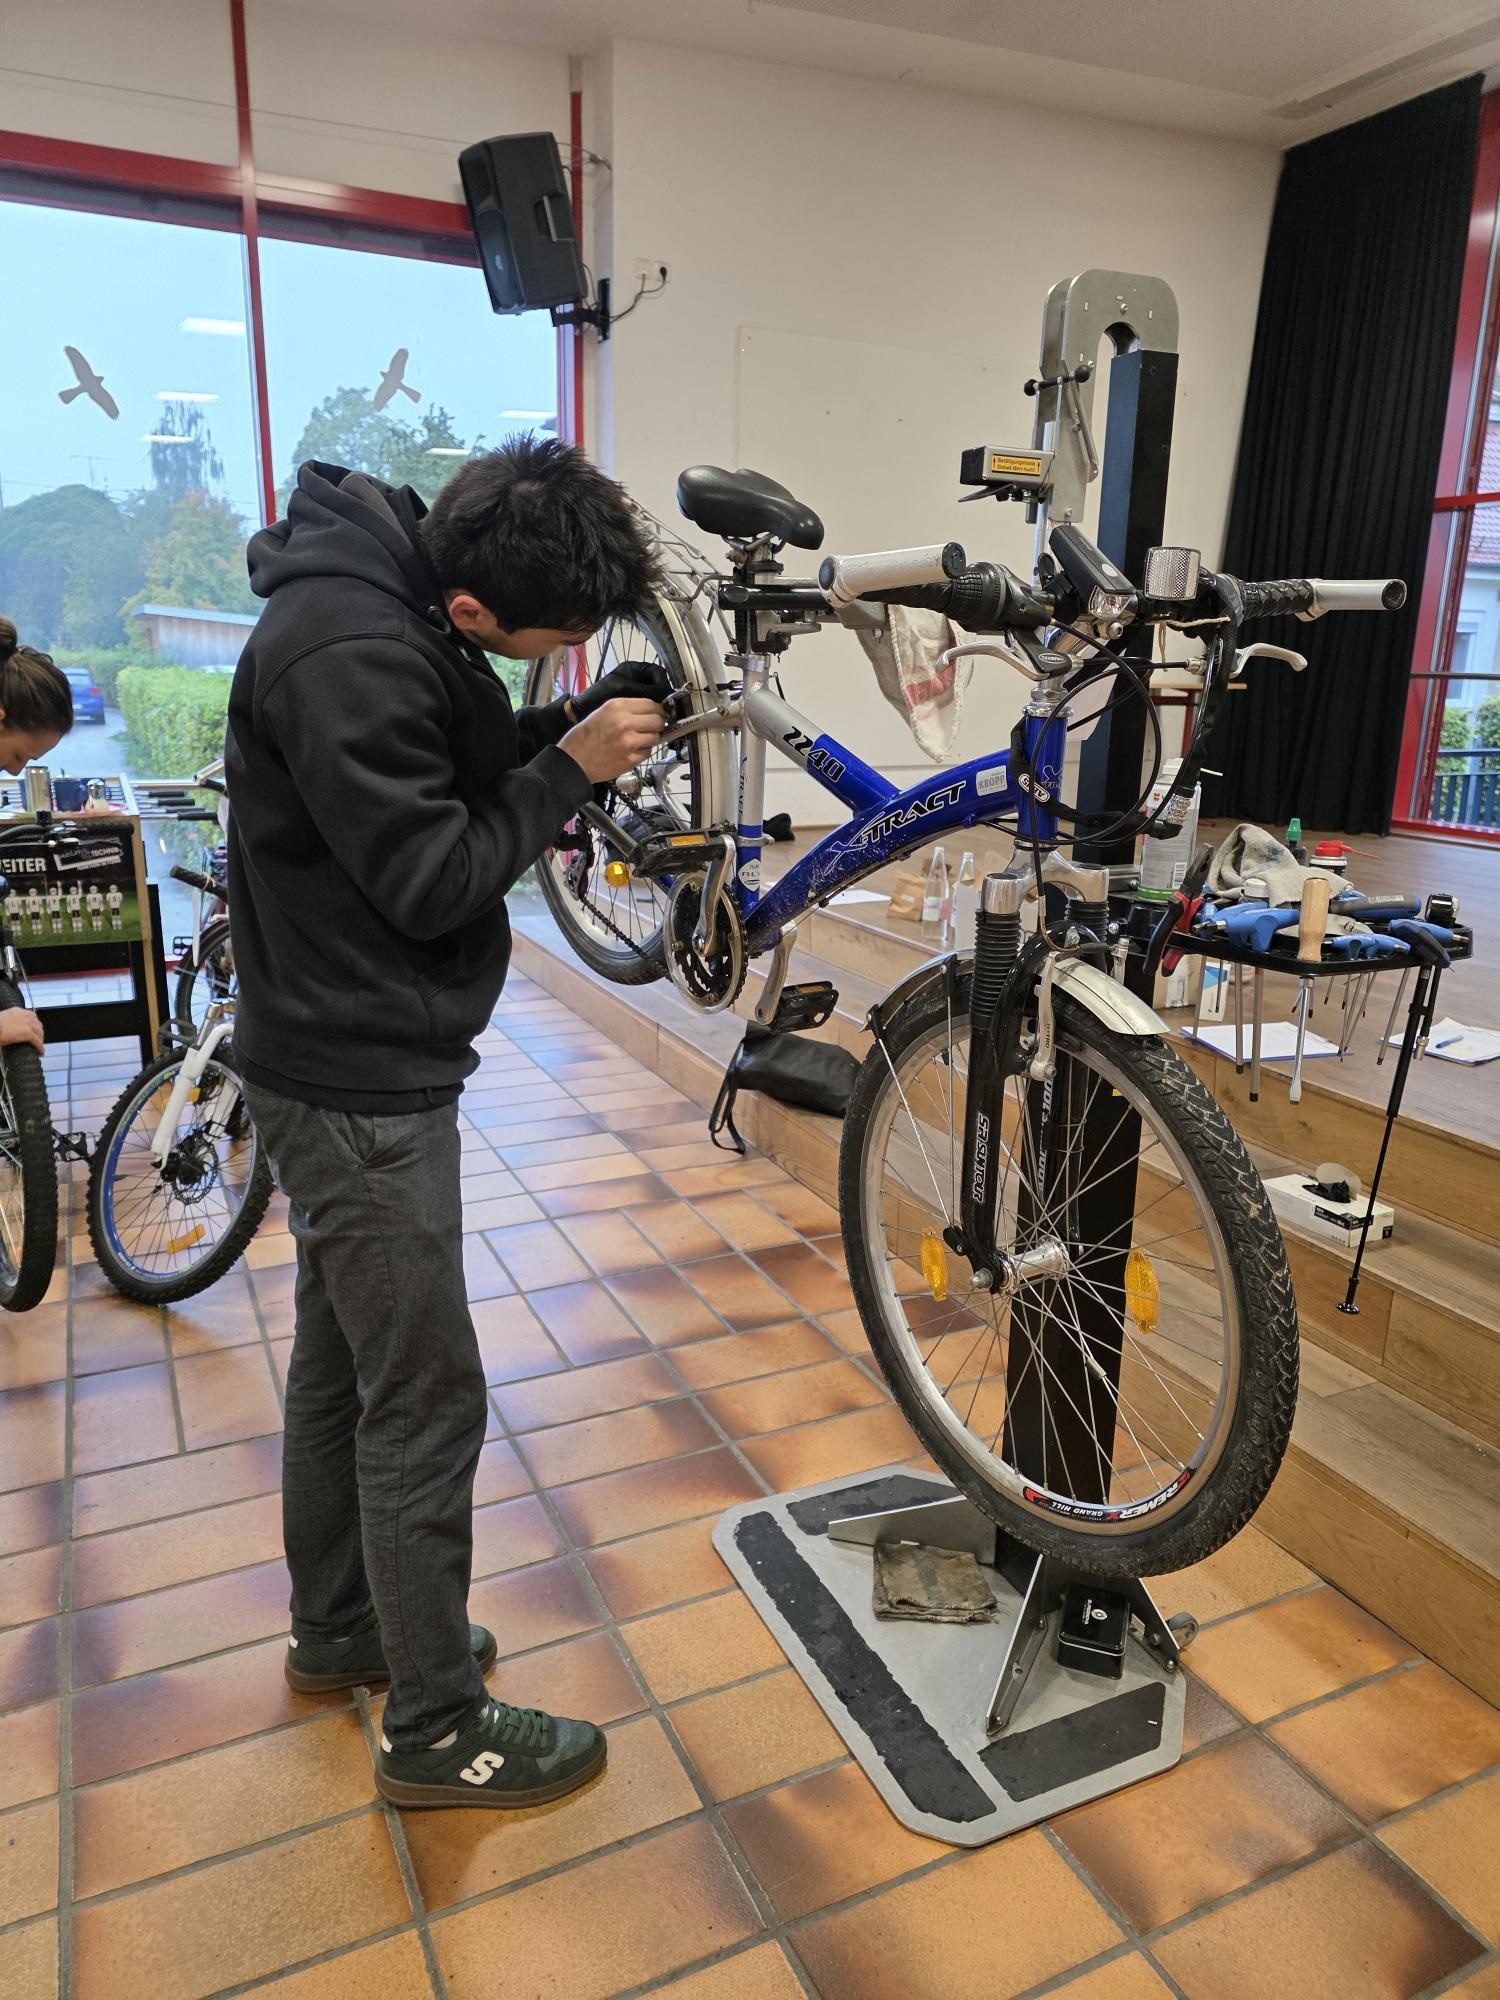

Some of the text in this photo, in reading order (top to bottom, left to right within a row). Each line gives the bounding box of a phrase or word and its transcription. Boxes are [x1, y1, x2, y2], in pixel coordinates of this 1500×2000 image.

[978, 774, 1005, 789] KROPP
[0, 857, 47, 873] EITER
[973, 1140, 988, 1203] SUNTOUR
[1051, 1501, 1072, 1512] HILL
[1073, 1507, 1104, 1518] GRAND
